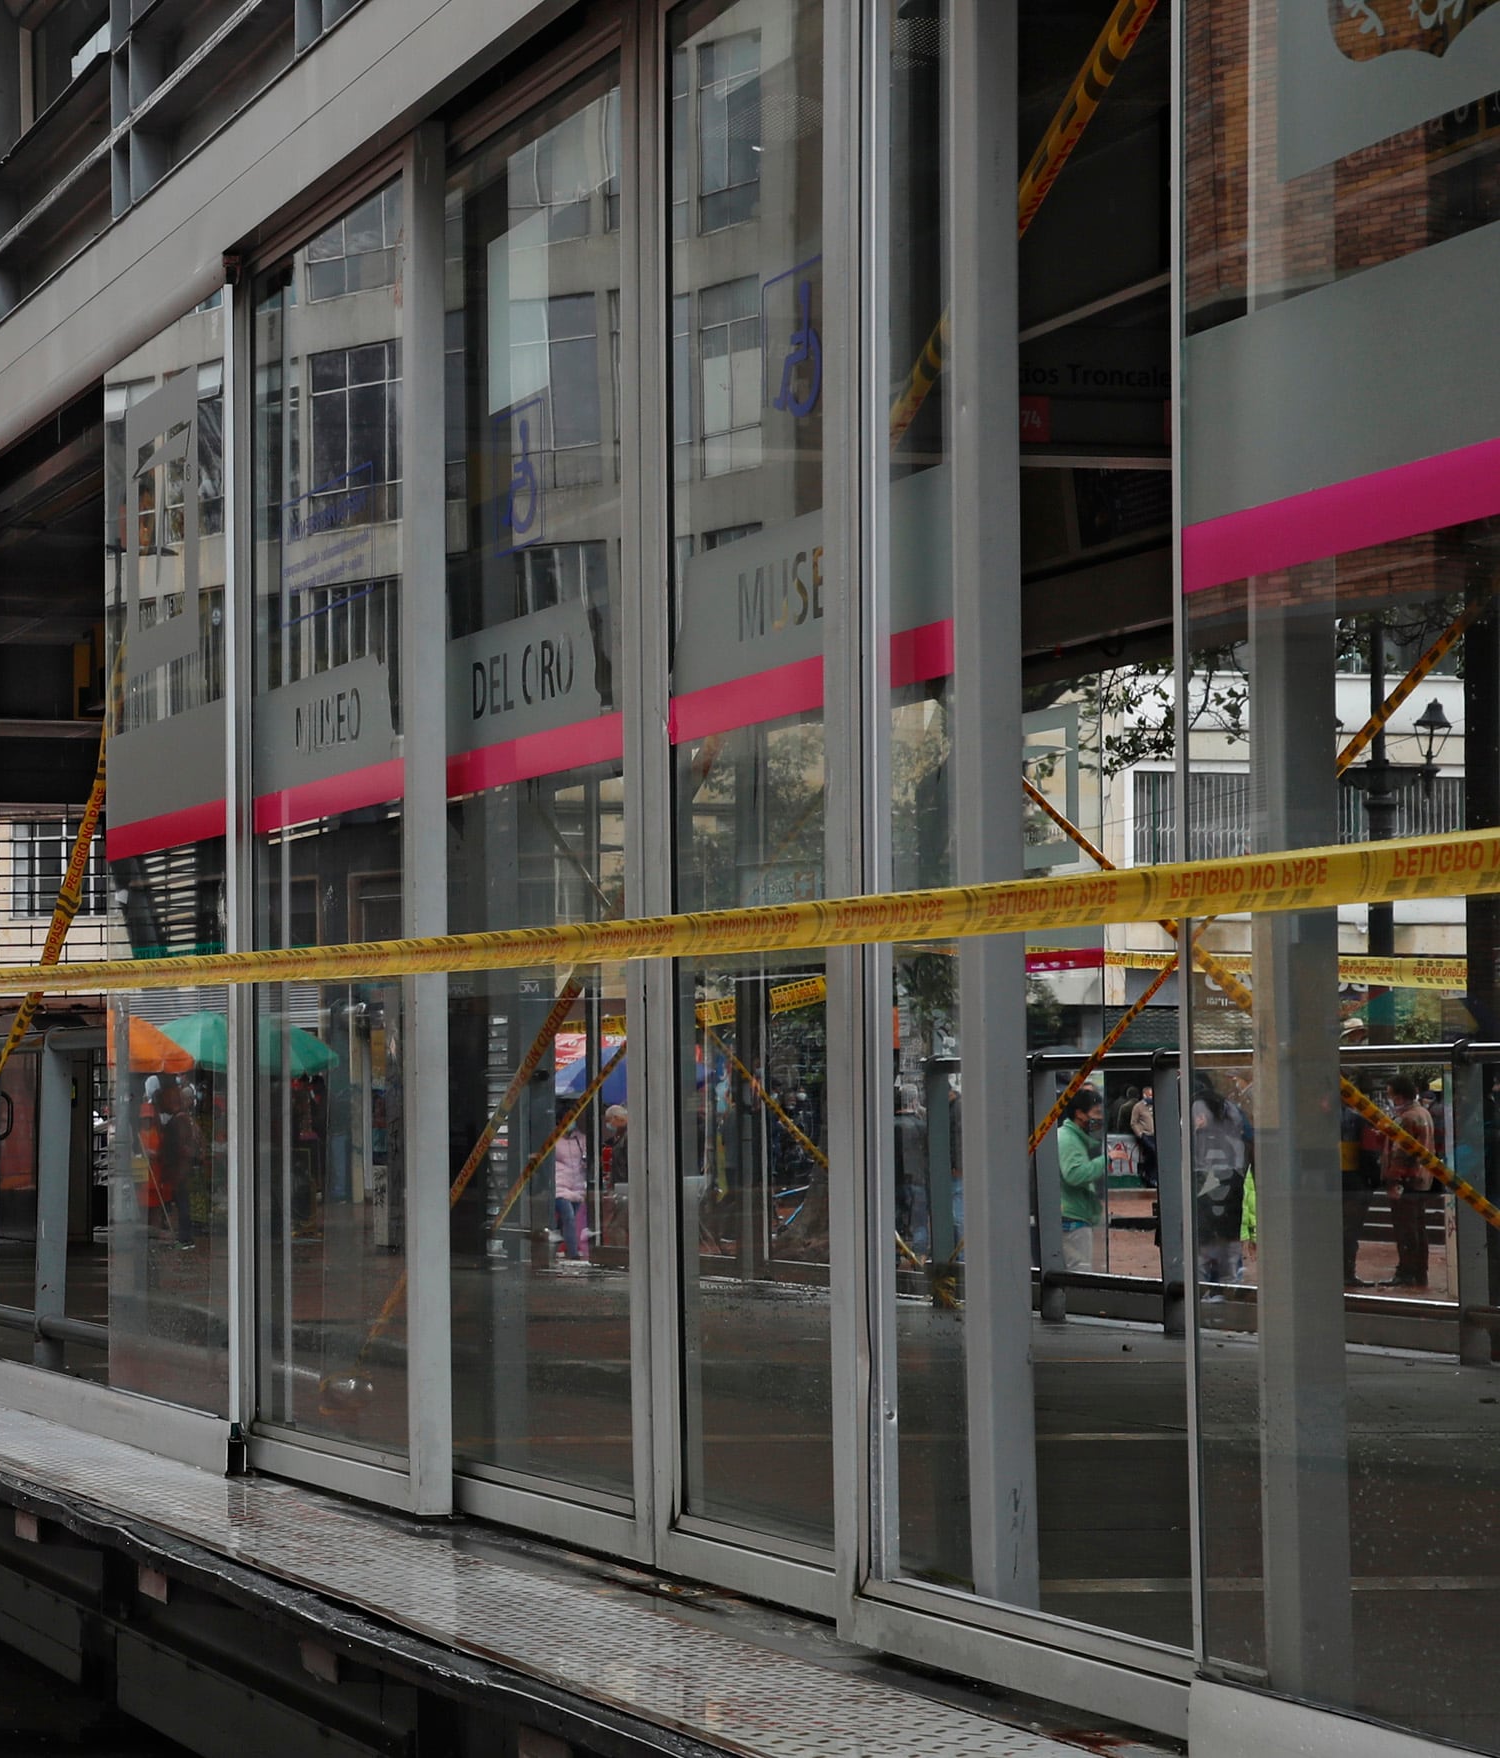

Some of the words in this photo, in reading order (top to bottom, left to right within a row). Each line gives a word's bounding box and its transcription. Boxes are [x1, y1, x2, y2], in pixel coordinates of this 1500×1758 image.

[295, 687, 361, 752] MUSEO
[472, 653, 514, 720] DEL
[522, 633, 574, 705] ORO
[65, 840, 89, 891] PELIGRO
[81, 818, 96, 840] NO
[45, 945, 57, 961] NO
[48, 916, 65, 945] PASE
